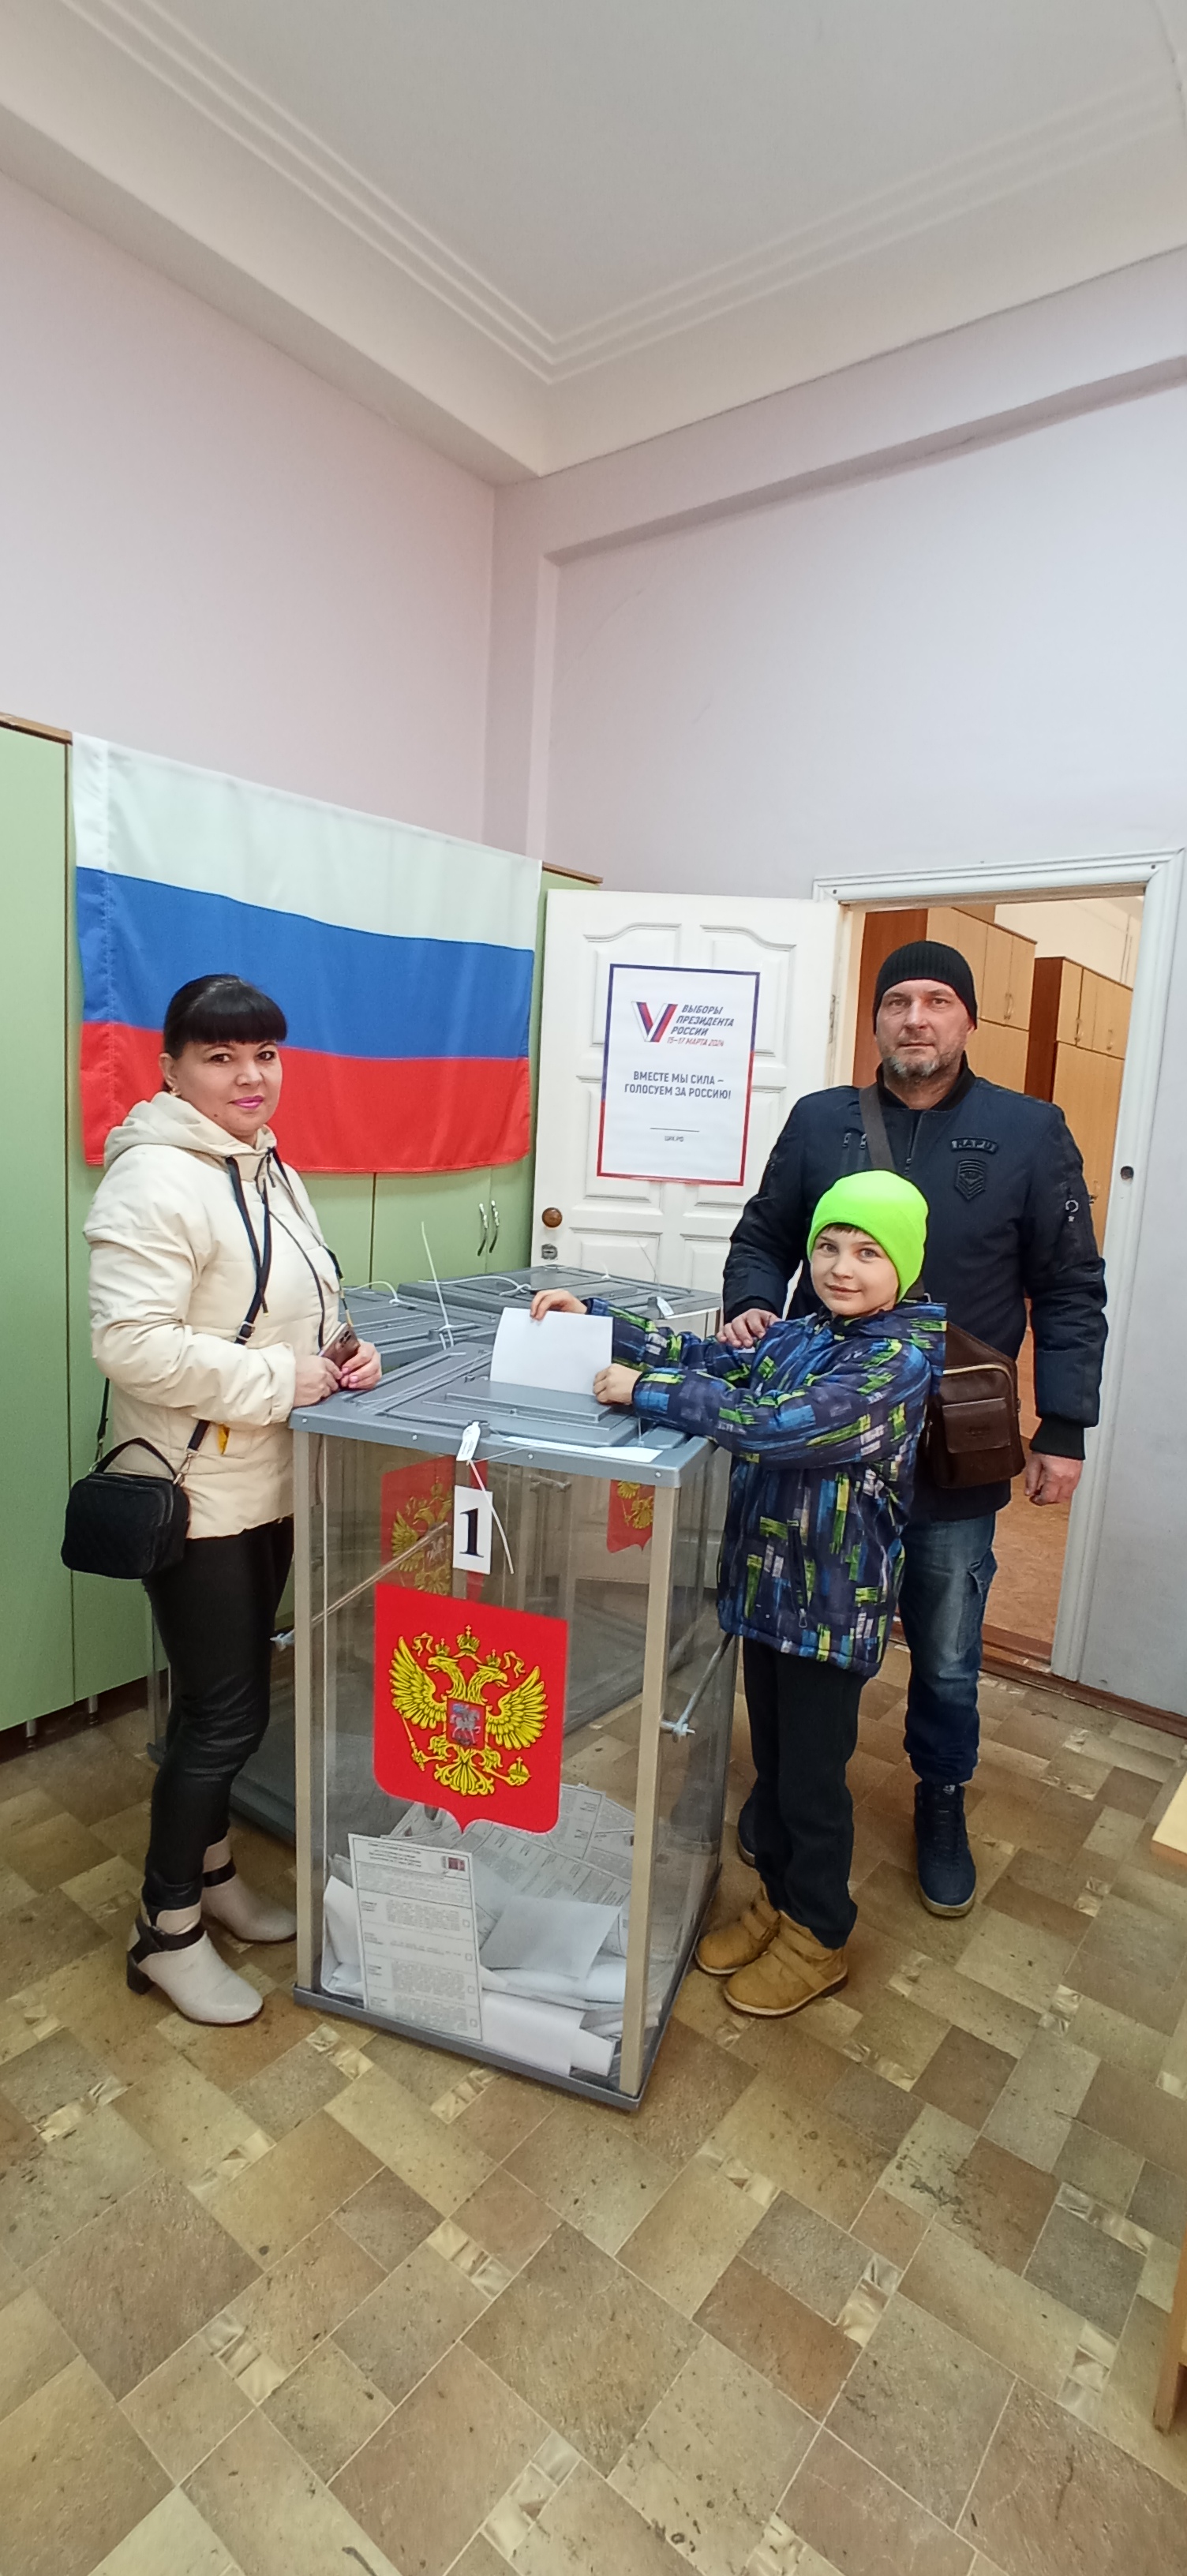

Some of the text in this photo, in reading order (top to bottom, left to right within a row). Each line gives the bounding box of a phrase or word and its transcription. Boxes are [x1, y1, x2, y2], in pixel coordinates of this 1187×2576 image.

[681, 1004, 724, 1015] ВЫБОРЫ
[676, 1015, 735, 1027] ПРЕЗИДЕНТА
[670, 1026, 709, 1036] РОССИИ
[685, 1038, 708, 1046] МАРТА
[633, 1070, 669, 1083] ВМЕСТЕ
[671, 1073, 689, 1084] МЫ
[691, 1074, 715, 1085] СИЛА
[624, 1083, 732, 1100] ГОЛОСУЕМ ЗА РОССИЮ!
[459, 1507, 484, 1558] 1
